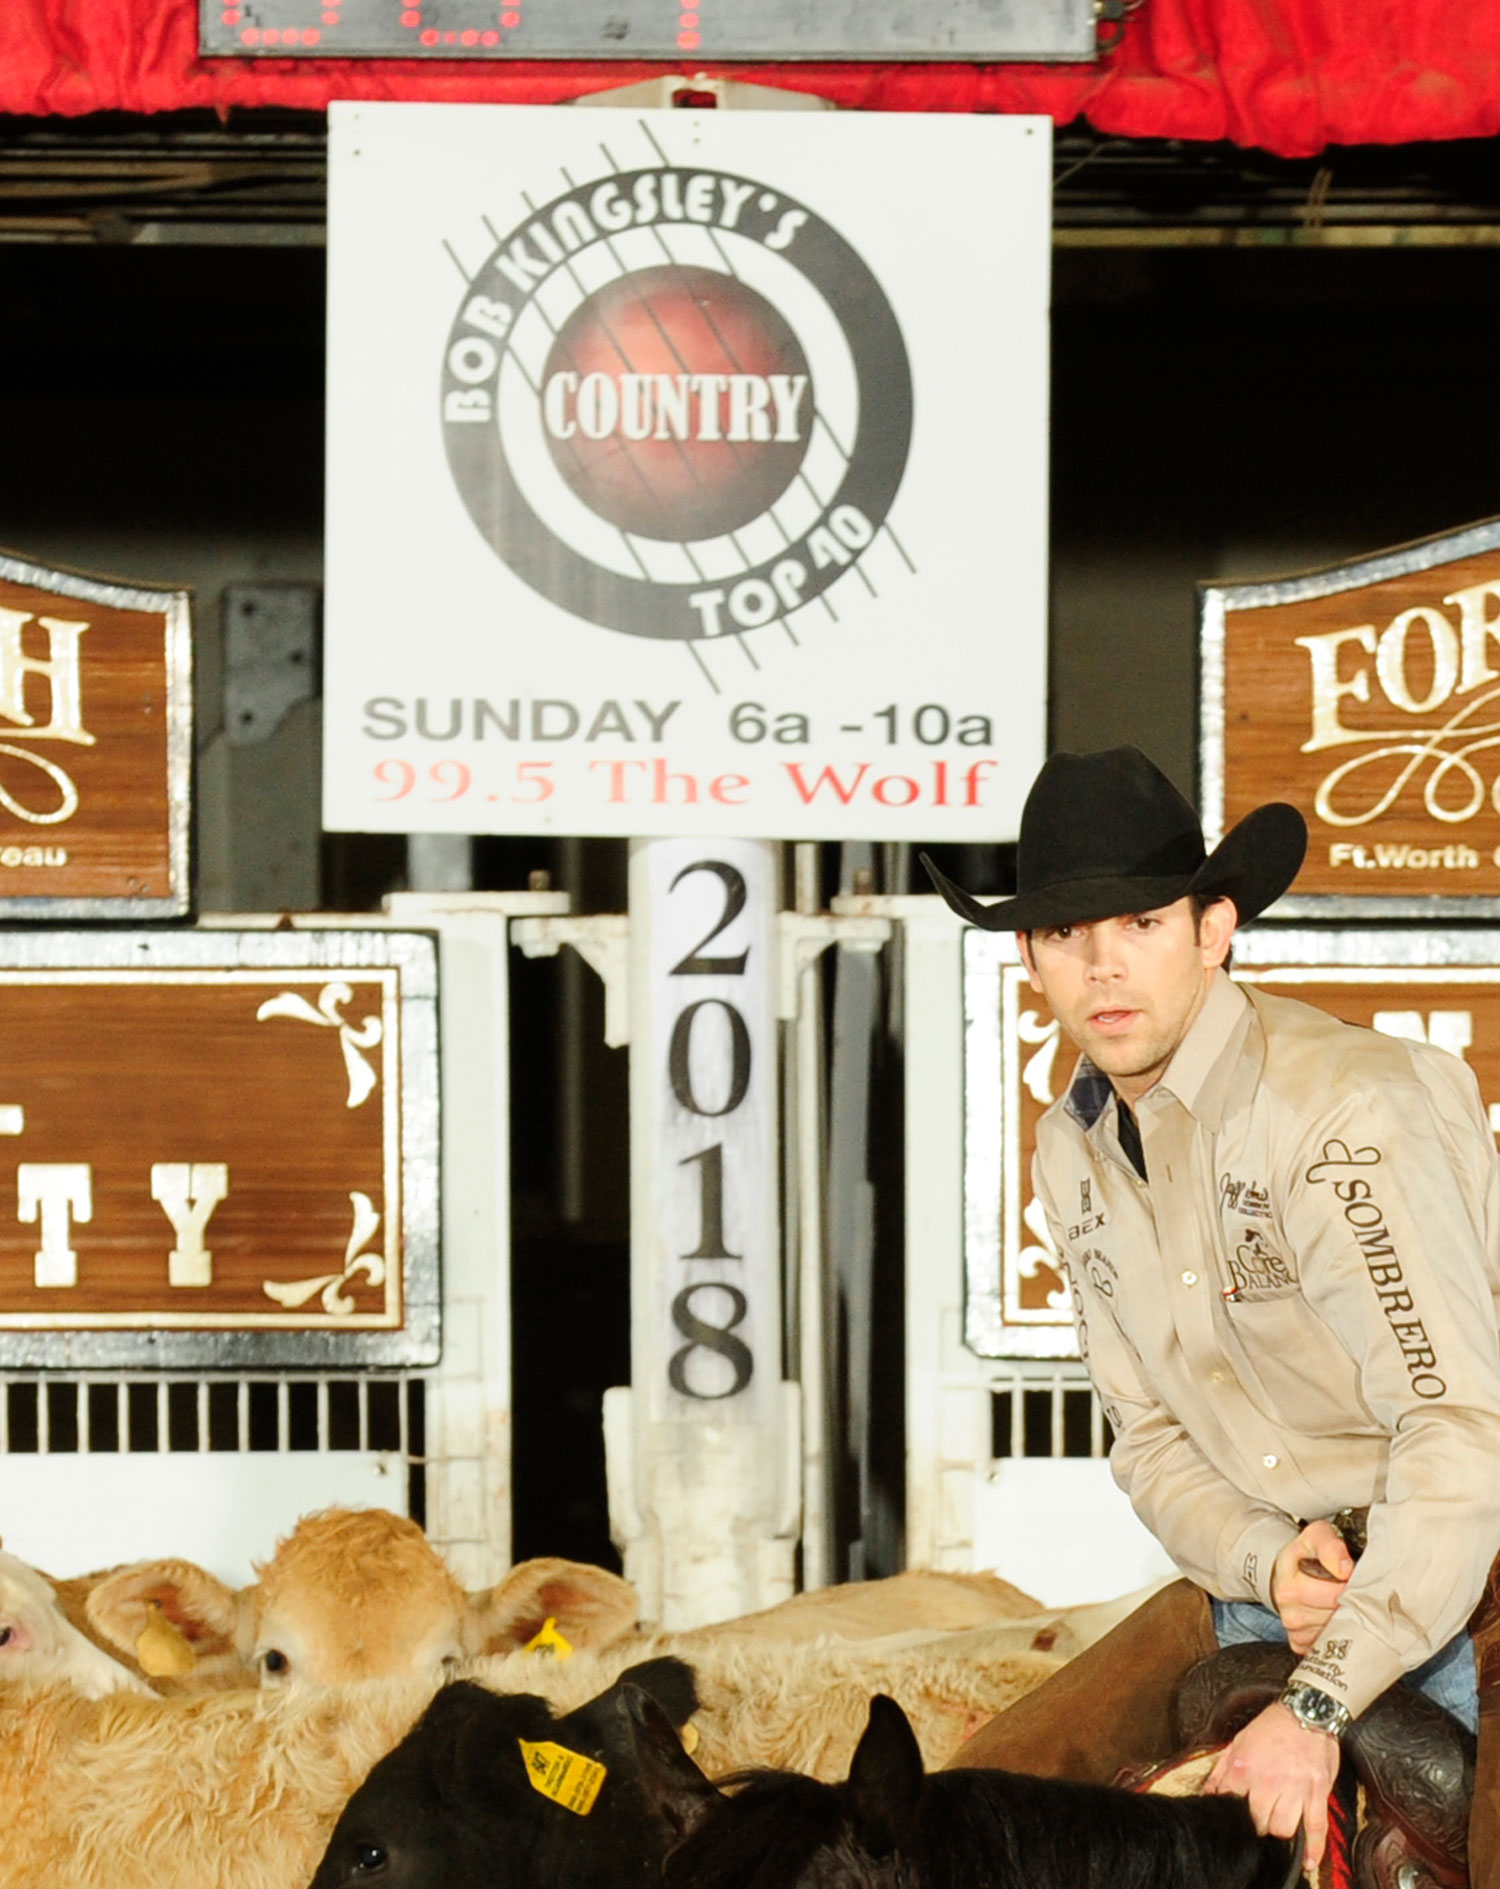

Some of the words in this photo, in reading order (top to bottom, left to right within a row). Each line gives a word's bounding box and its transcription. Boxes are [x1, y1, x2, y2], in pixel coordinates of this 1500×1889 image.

[445, 295, 512, 423] BOB
[496, 173, 807, 294] KINGSLEY'S
[542, 372, 807, 442] COUNTRY
[690, 560, 807, 636] TOP
[807, 505, 875, 568] 40
[361, 696, 683, 743] SUNDAY
[728, 702, 811, 746] 6a
[371, 757, 556, 804] 99.5
[589, 756, 752, 805] The
[781, 759, 999, 808] Wolf
[0, 845, 68, 868] eau
[1329, 844, 1479, 870] Ft.Worth
[667, 859, 755, 1400] 2018
[1331, 1179, 1447, 1400] SOMBRERO
